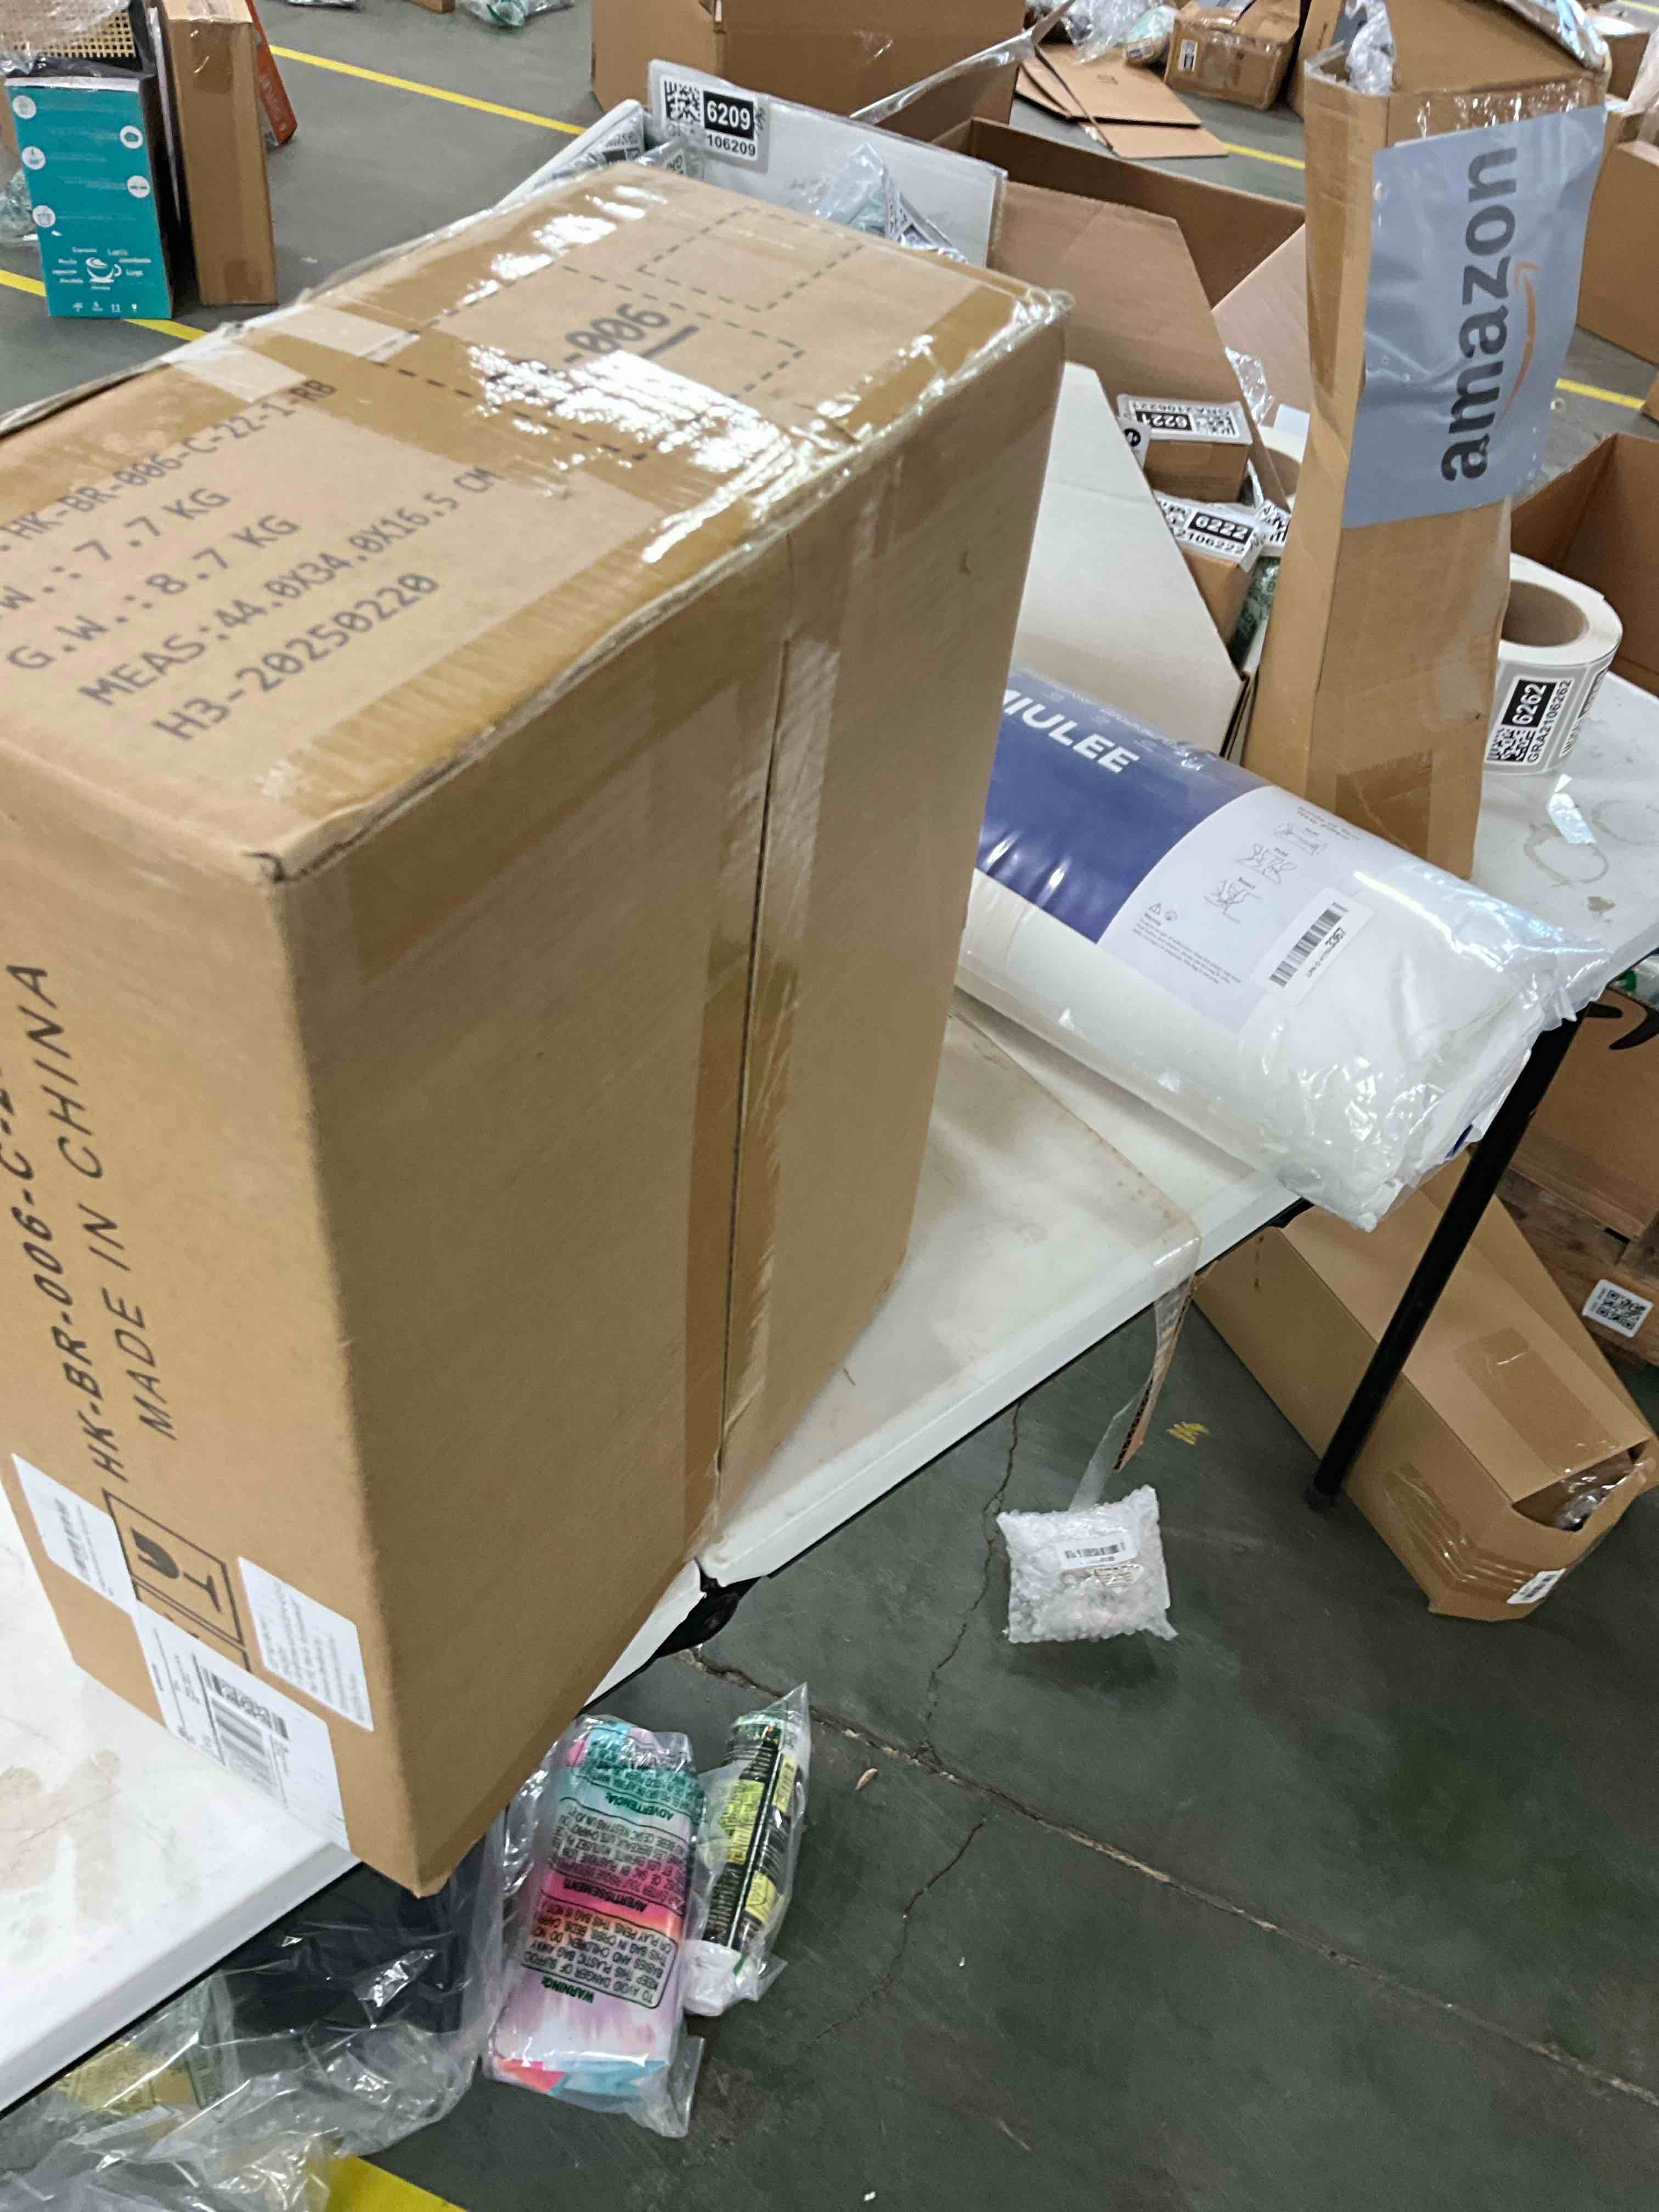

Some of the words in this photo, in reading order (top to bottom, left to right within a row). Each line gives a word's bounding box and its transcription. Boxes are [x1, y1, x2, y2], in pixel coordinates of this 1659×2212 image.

[707, 100, 751, 130] 6209
[1441, 147, 1517, 482] amazon
[1142, 413, 1188, 428] 6221
[454, 466, 504, 493] CM
[162, 488, 231, 521] KG
[230, 515, 303, 549] KG
[151, 573, 438, 741] H3-20250220
[1511, 683, 1547, 725] 6262
[1527, 680, 1572, 763] GRA2106262
[5, 964, 104, 1179] CHINA
[77, 1202, 132, 1272] IN
[101, 1286, 178, 1441] MADE
[540, 1975, 595, 2004] WARNING:
